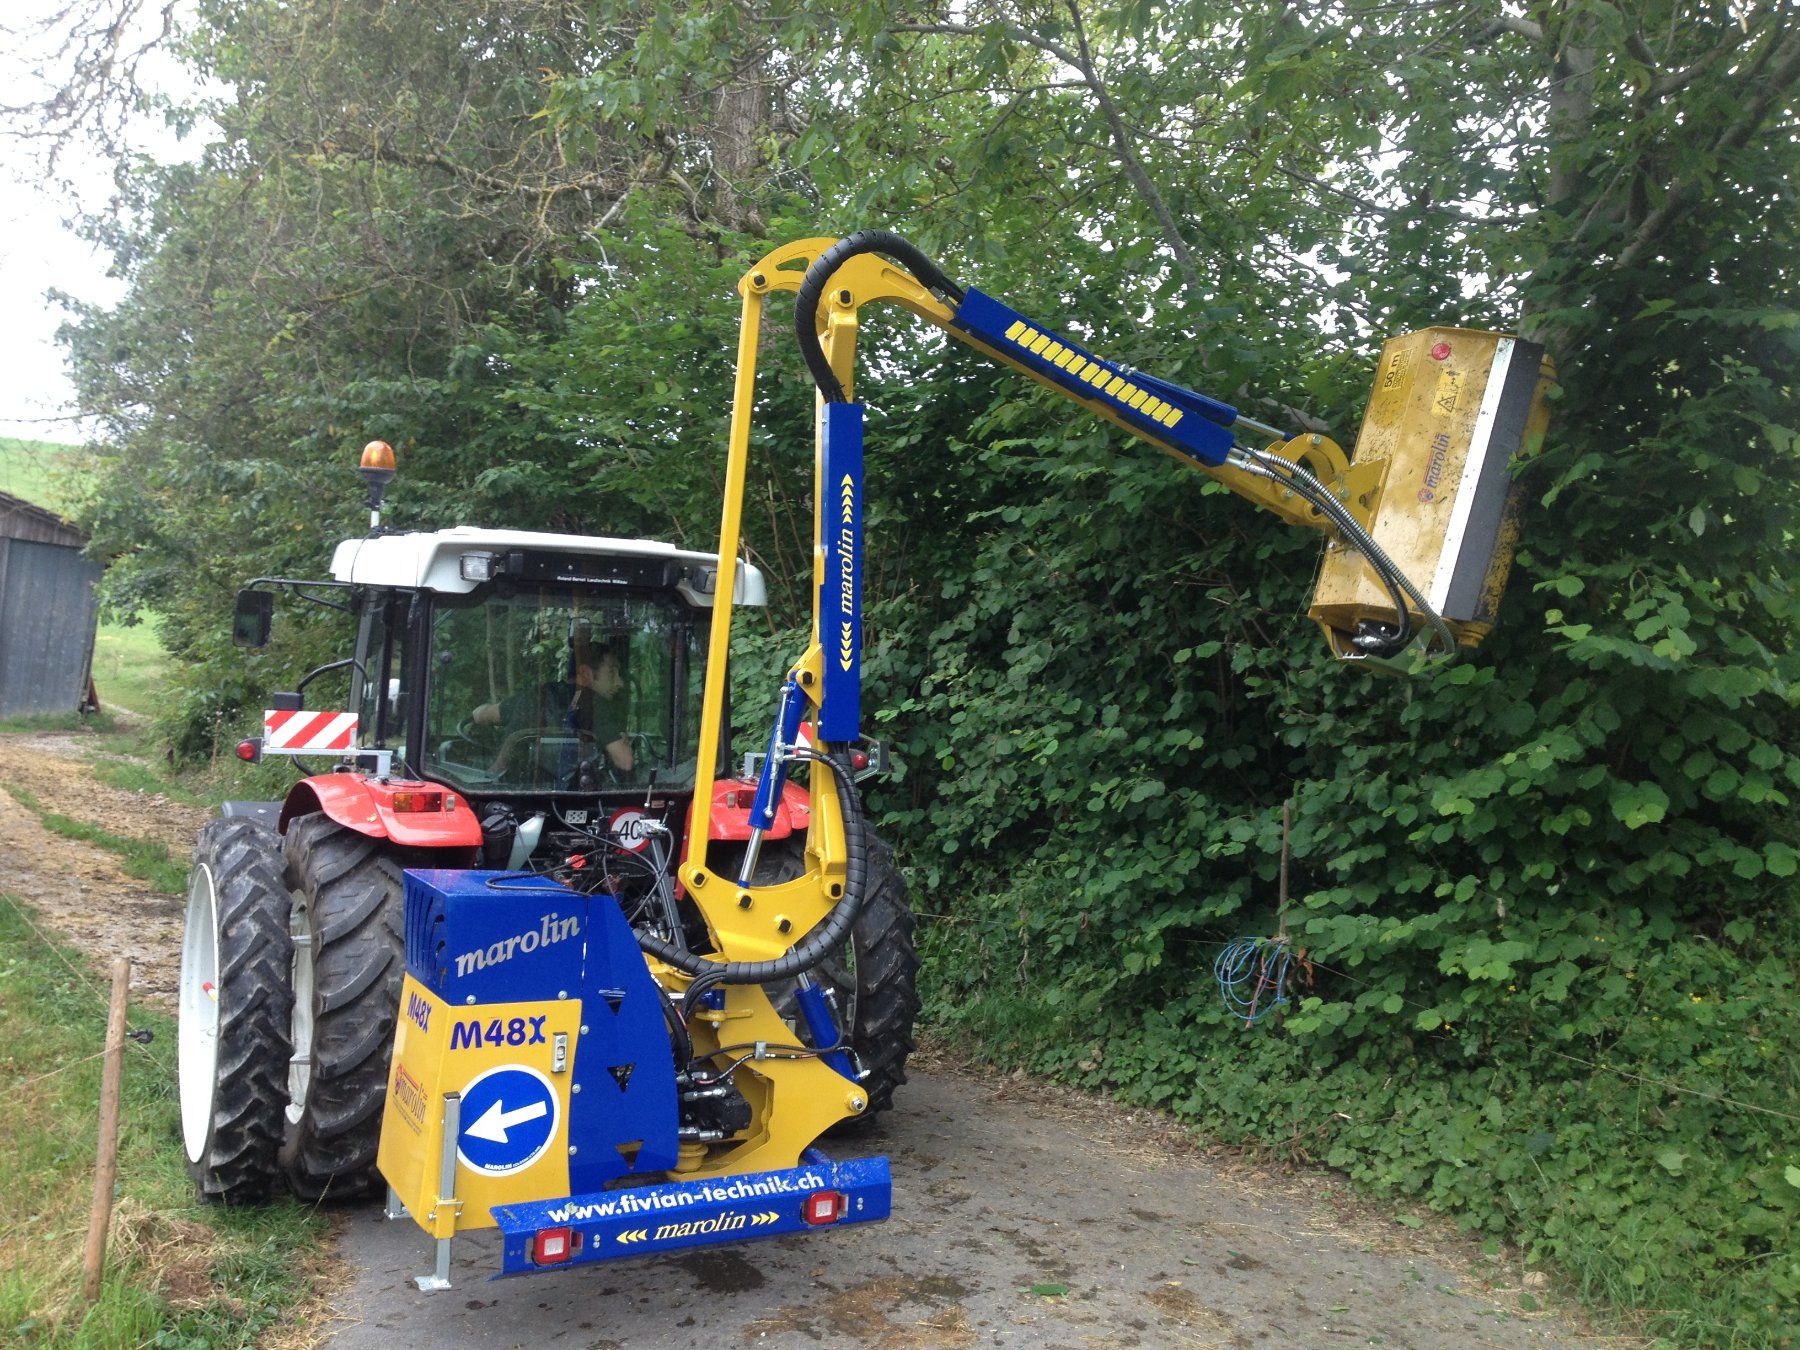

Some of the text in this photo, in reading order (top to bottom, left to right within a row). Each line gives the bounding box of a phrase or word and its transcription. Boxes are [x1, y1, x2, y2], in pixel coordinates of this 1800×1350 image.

[1384, 371, 1395, 388] 50
[1426, 433, 1450, 489] marolin
[837, 528, 853, 616] marolin
[455, 912, 580, 978] marolin
[407, 991, 431, 1033] M48X
[450, 1015, 546, 1050] M48X
[400, 1080, 426, 1124] marolin
[548, 1171, 825, 1223] www.fivian-technik.ch
[653, 1211, 746, 1241] marolin
